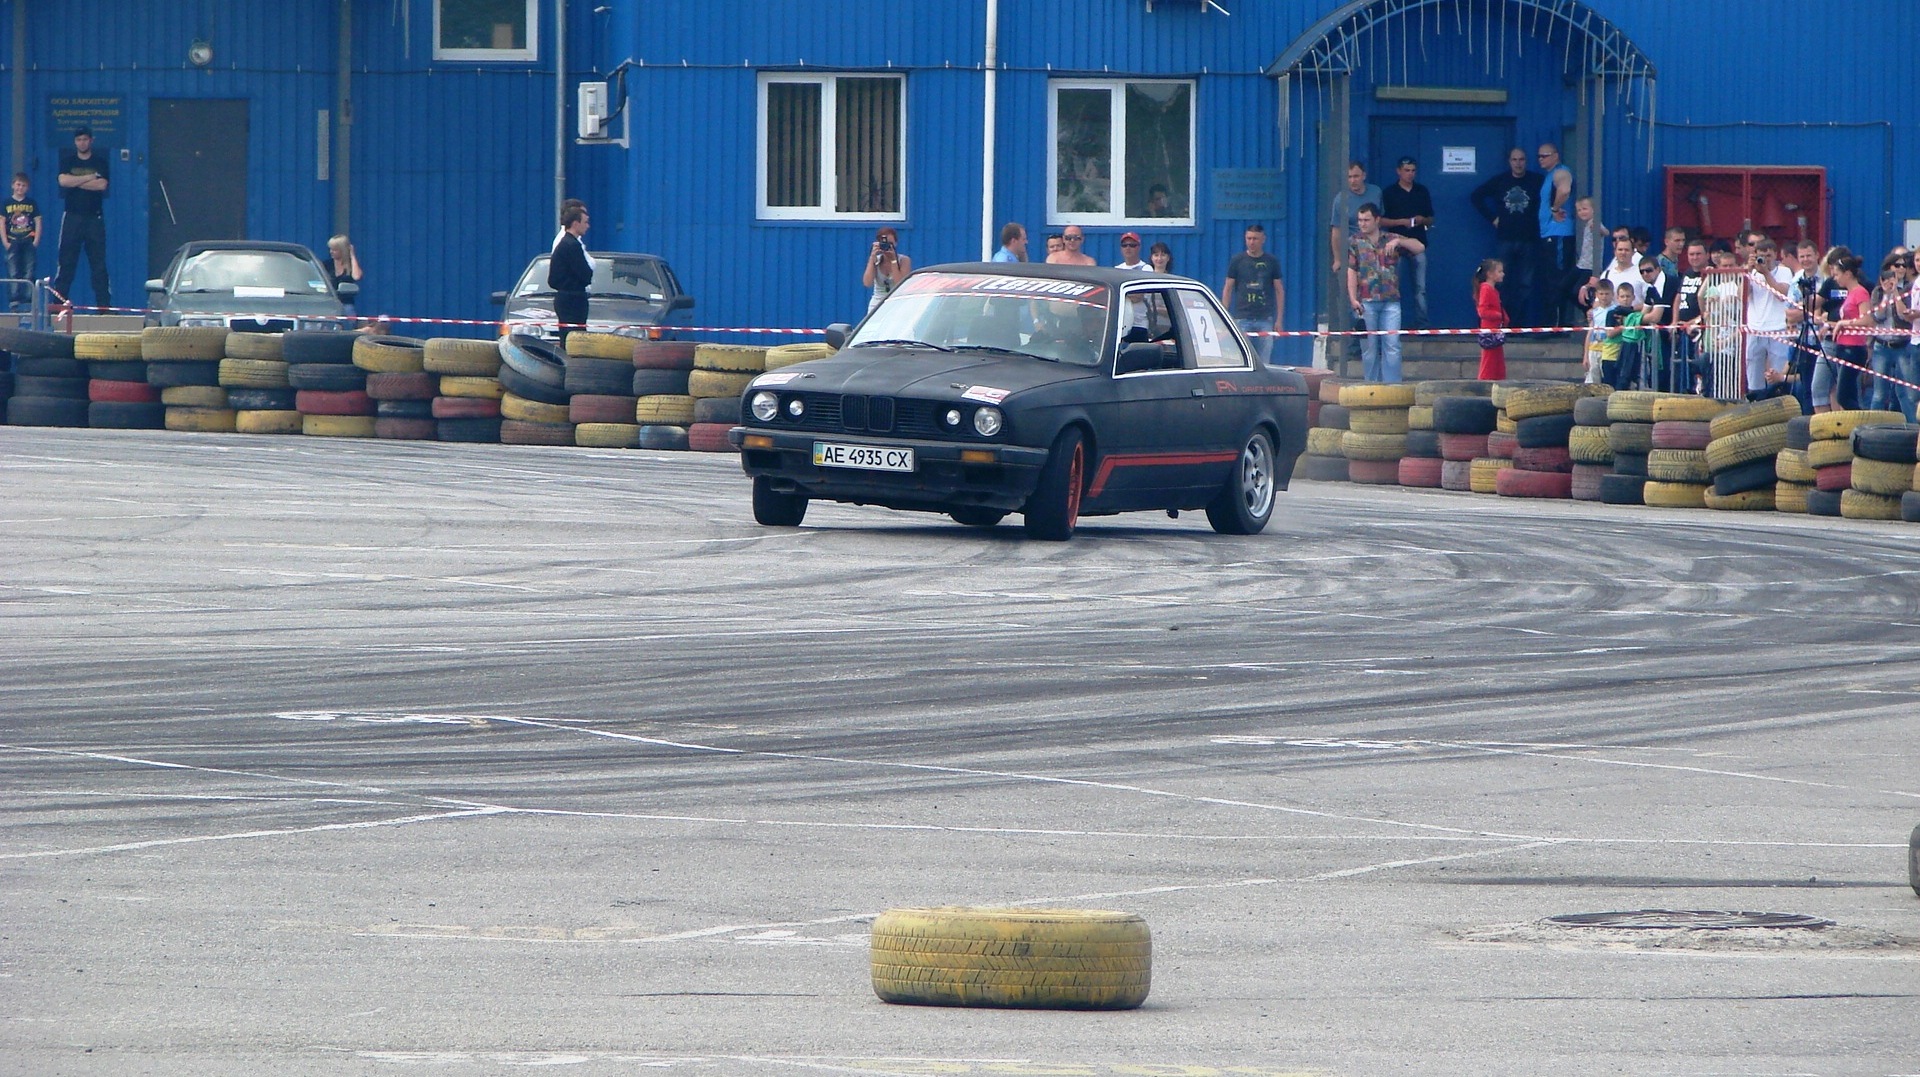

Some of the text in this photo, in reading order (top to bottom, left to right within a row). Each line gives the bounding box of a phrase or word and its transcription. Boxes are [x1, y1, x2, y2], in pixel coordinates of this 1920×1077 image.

[1200, 315, 1210, 343] 2
[824, 447, 909, 468] AE 4935 CX
